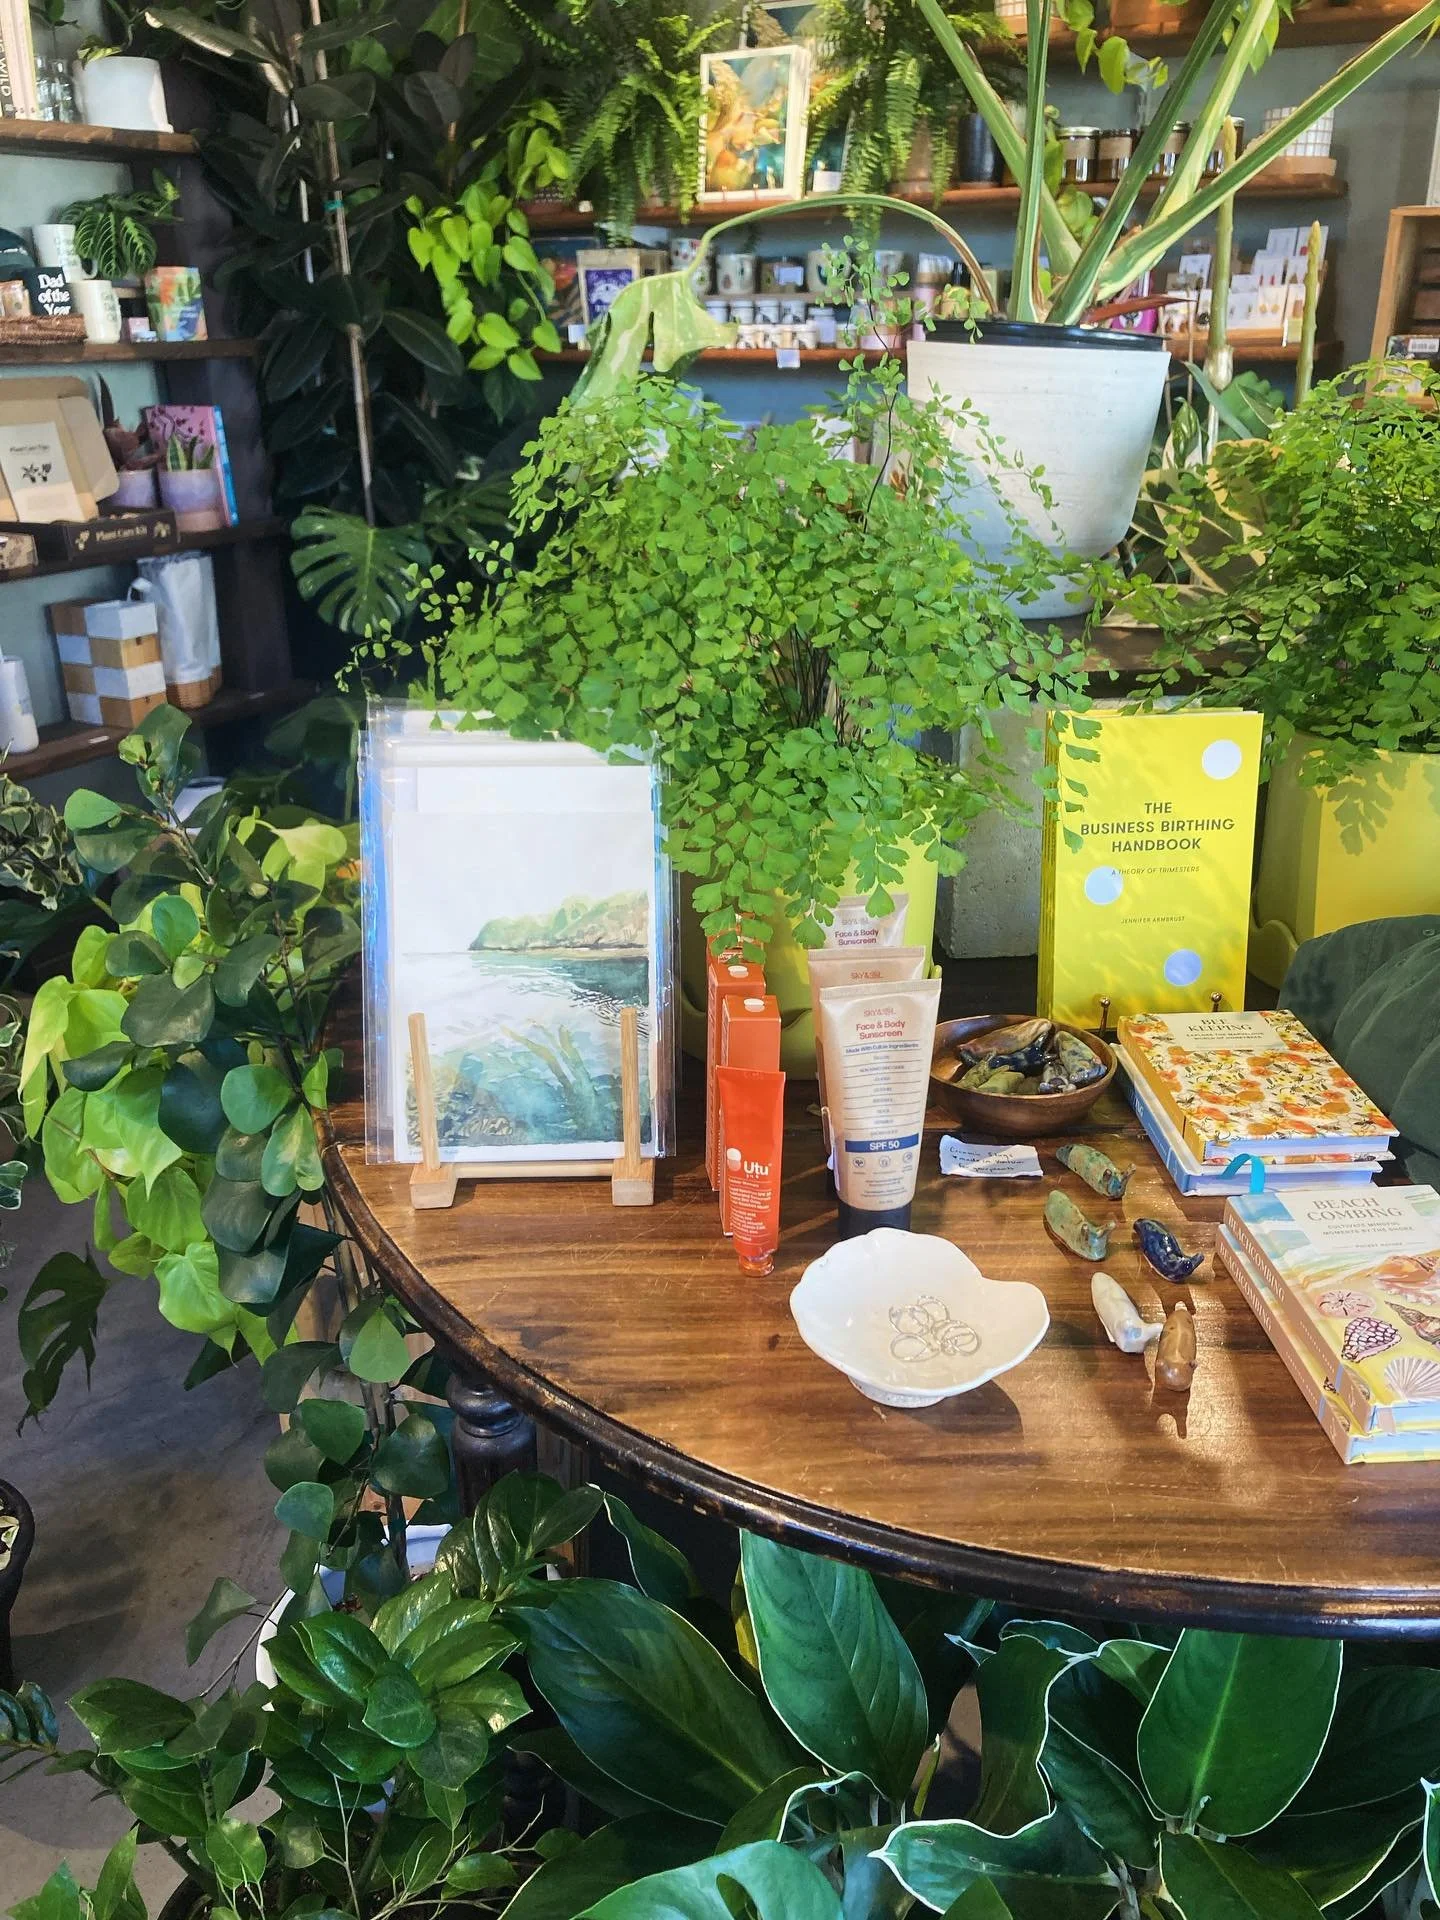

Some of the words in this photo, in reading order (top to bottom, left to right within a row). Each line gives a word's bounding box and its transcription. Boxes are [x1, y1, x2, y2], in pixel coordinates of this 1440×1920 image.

[38, 273, 65, 289] Dad
[38, 288, 52, 304] of
[51, 288, 71, 303] the
[43, 303, 72, 315] Year
[1144, 802, 1173, 814] THE
[1080, 821, 1155, 836] BUSINESS
[1160, 818, 1235, 833] BIRTHING
[1111, 838, 1202, 853] HANDBOOK
[1118, 867, 1145, 876] THEORY
[1147, 867, 1157, 875] OF
[1159, 865, 1200, 874] TRIMESTERS
[835, 930, 853, 939] Face
[854, 930, 860, 938] &
[860, 927, 880, 938] Body
[838, 937, 877, 947] Sunscreen
[856, 1023, 876, 1032] Face
[877, 1022, 884, 1030] &
[884, 1019, 906, 1031] Body
[1188, 1024, 1252, 1032] KEEPING
[859, 1027, 903, 1040] Sunscreen
[869, 1142, 888, 1151] SPF
[888, 1140, 900, 1149] 50
[743, 1160, 769, 1177] Utu
[1311, 1198, 1380, 1210] BEACH
[1306, 1207, 1403, 1221] COMBING
[1228, 1214, 1285, 1303] BEACHCOMBING
[1219, 1241, 1273, 1334] BEACHCOMBING
